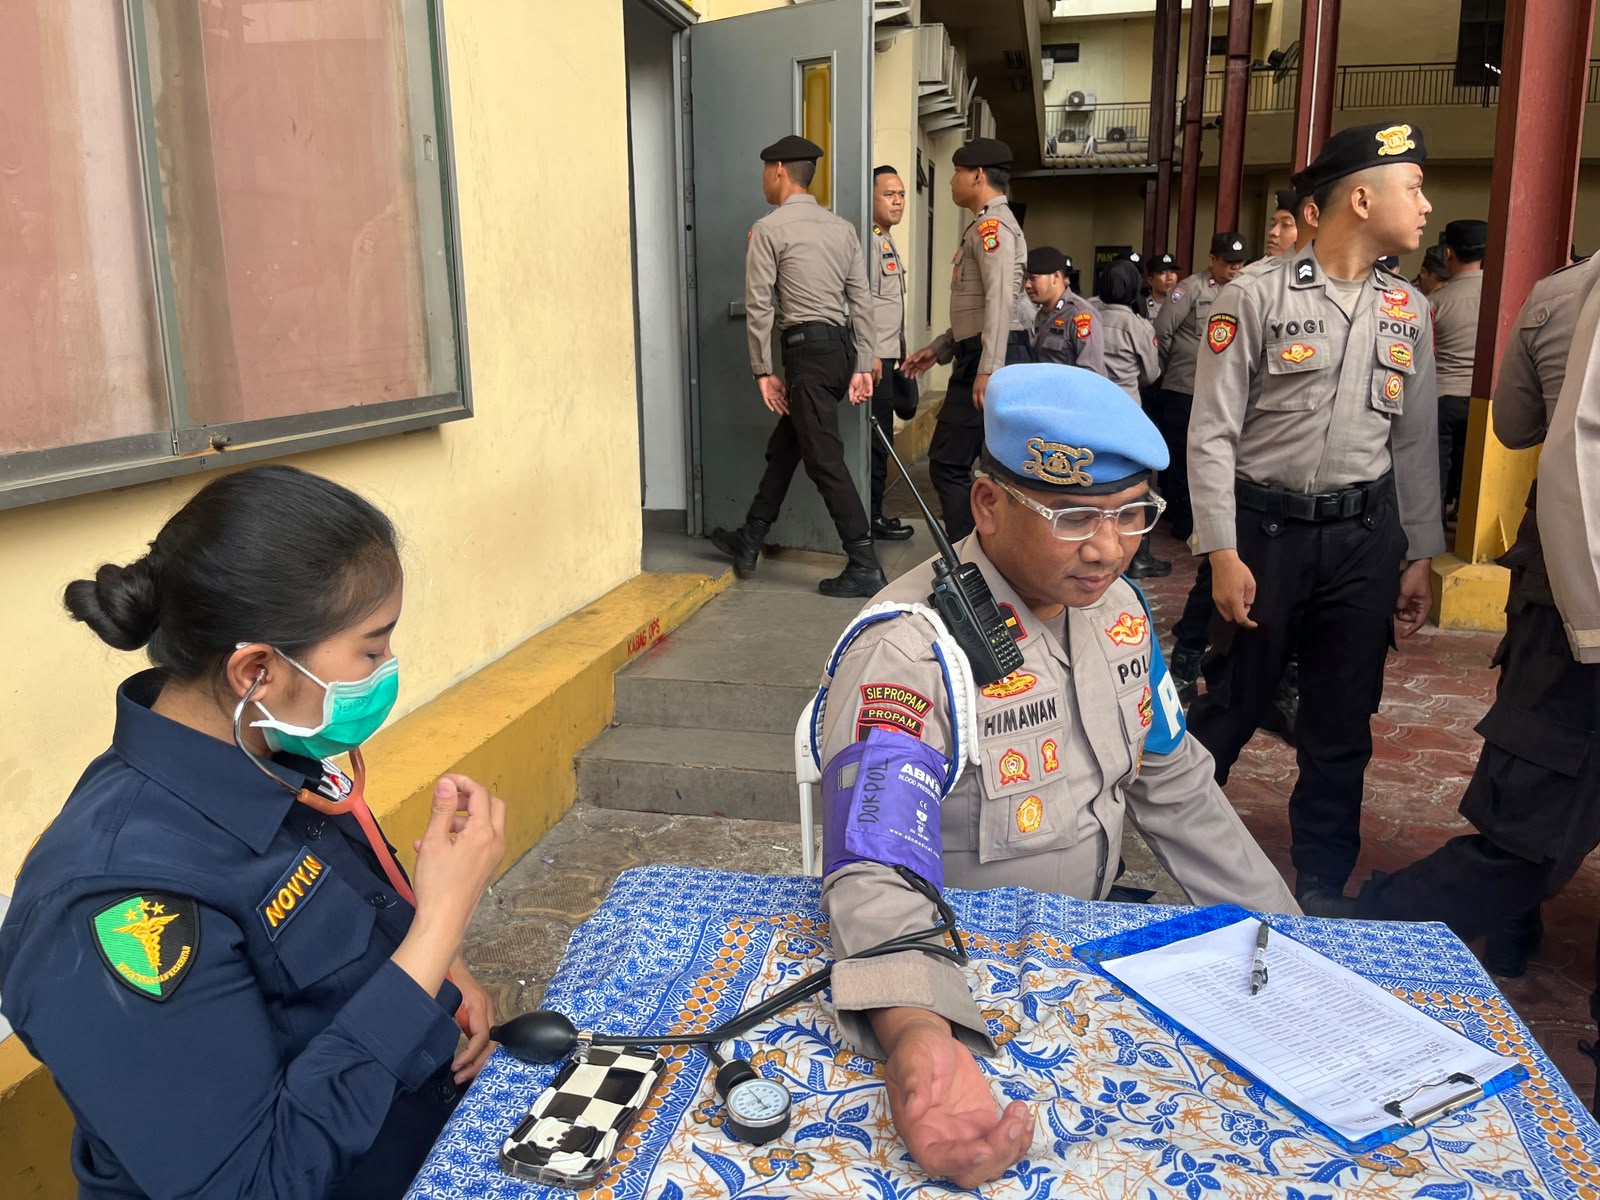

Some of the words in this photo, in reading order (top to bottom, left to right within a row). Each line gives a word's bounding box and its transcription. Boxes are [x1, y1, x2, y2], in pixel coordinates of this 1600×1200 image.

[1271, 319, 1326, 339] YOGI
[1379, 319, 1419, 341] POLRI
[866, 687, 882, 700] SIE
[883, 687, 927, 713] PROPAM
[868, 709, 917, 730] PROPAM
[983, 697, 1058, 738] HIMAWAN
[857, 757, 889, 823] DOKPOL
[265, 854, 323, 928] NOVY.N
